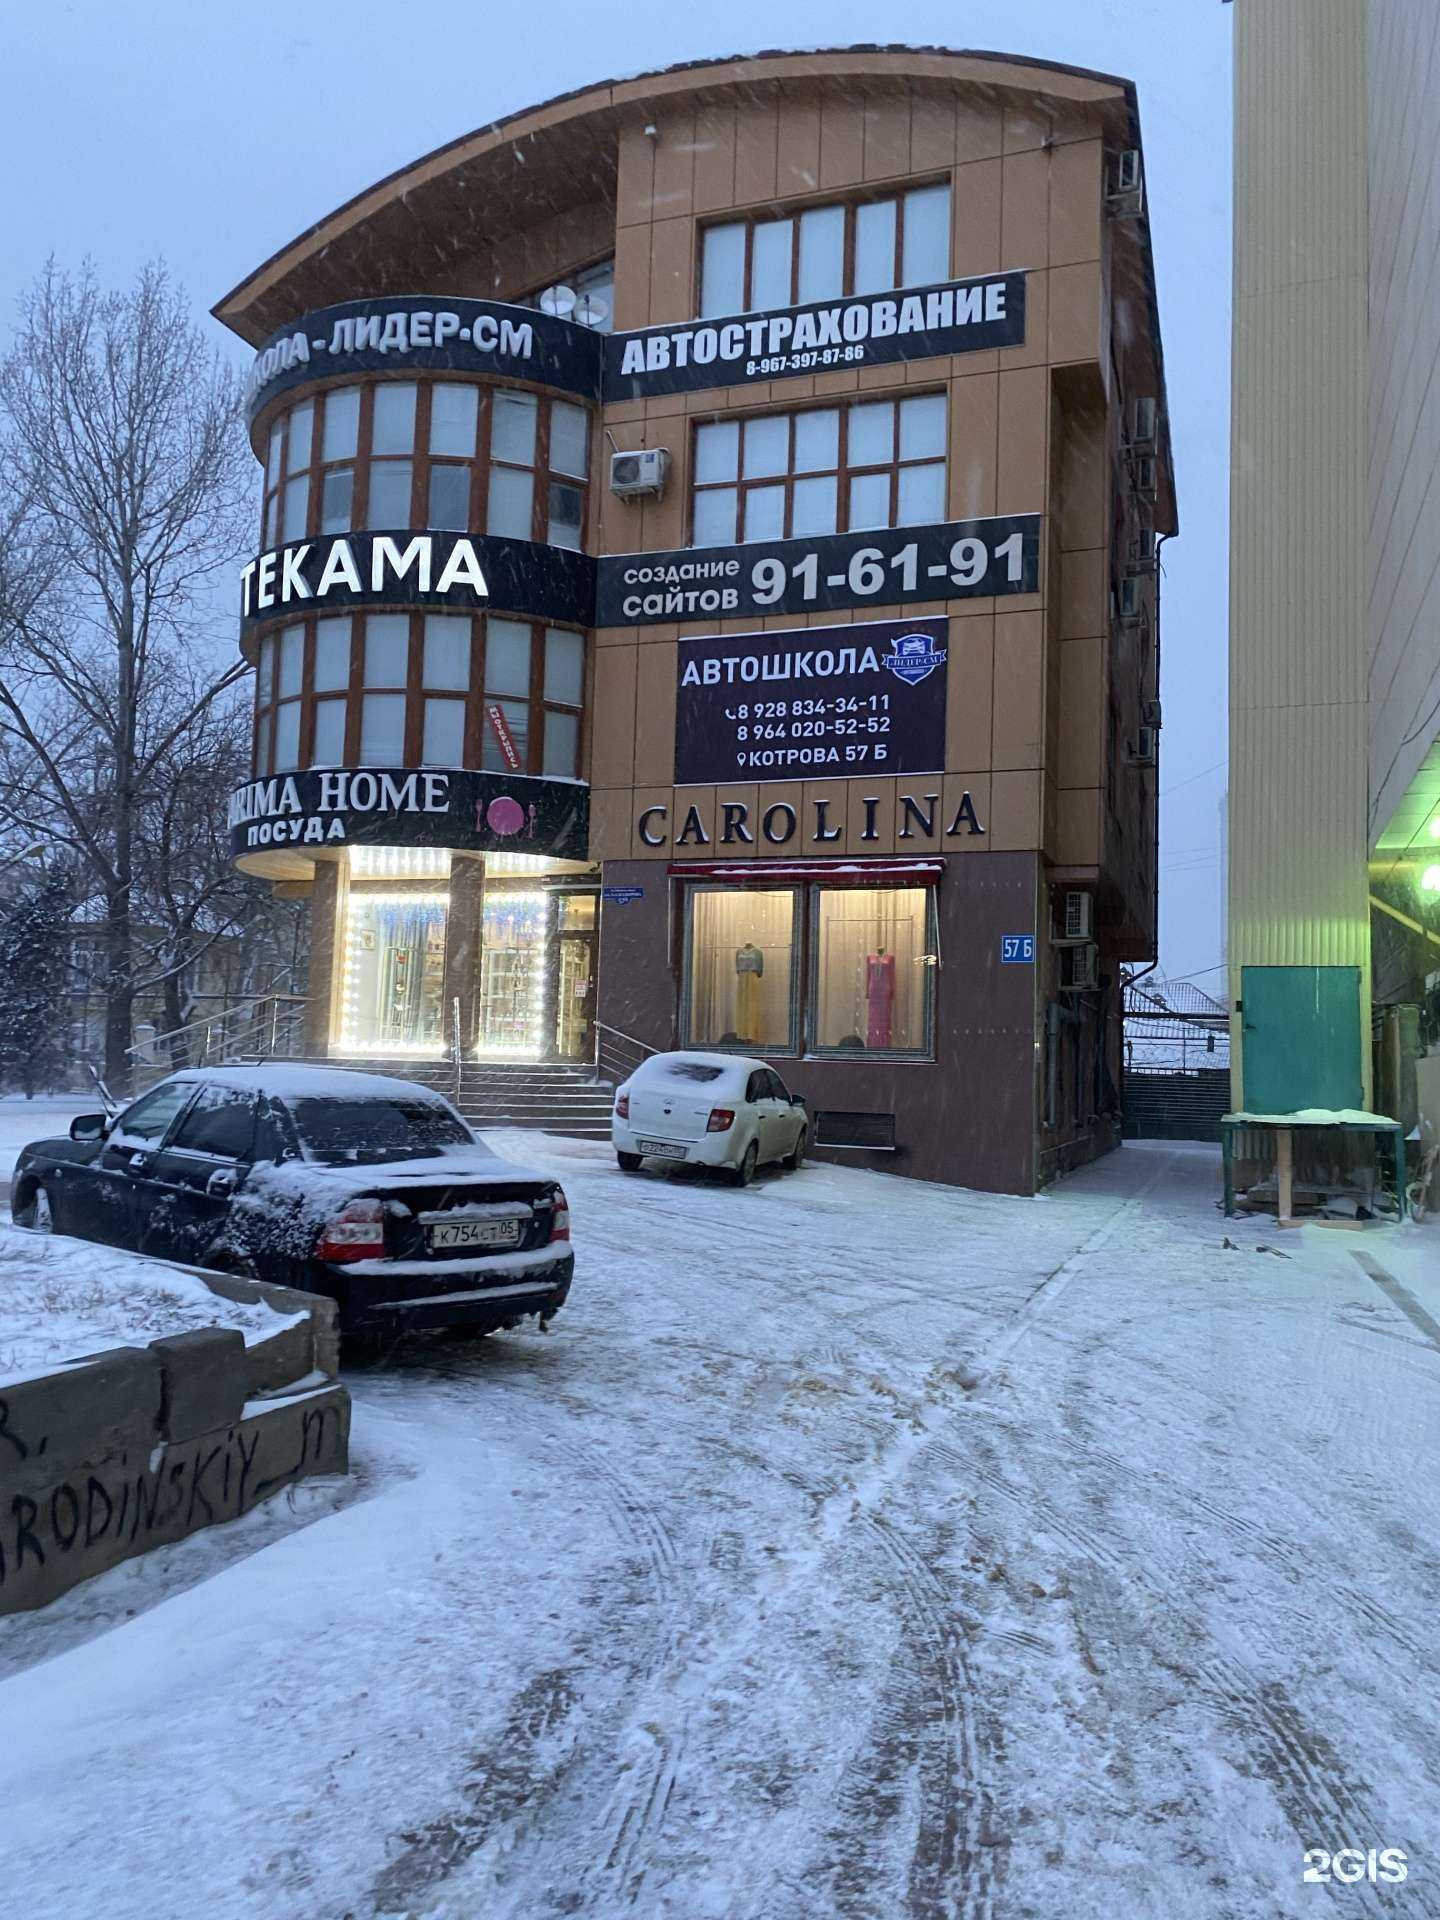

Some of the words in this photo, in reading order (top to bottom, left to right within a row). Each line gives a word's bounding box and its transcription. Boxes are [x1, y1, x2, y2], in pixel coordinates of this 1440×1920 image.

[620, 282, 1007, 375] АВТОСТРАХОВАНИЕ
[746, 345, 864, 376] 8-967-397-87-86
[623, 558, 740, 585] создание
[751, 533, 1024, 605] 91-61-91
[622, 586, 739, 617] сайтов
[681, 646, 880, 687] АВТОШКОЛА
[737, 704, 748, 720] 8
[753, 701, 787, 719] 928
[791, 694, 889, 716] 834-34-11
[737, 726, 748, 741] 8
[753, 724, 786, 740] 964
[791, 716, 890, 738] 020-52-52
[749, 745, 840, 767] КОТРОВА
[845, 744, 868, 761] 57
[874, 743, 888, 760] Б
[318, 772, 449, 813] HOME
[247, 817, 345, 847] ПОСУДА
[637, 790, 986, 848] CAROLINA
[1004, 939, 1020, 958] 57
[1023, 939, 1032, 958] Б
